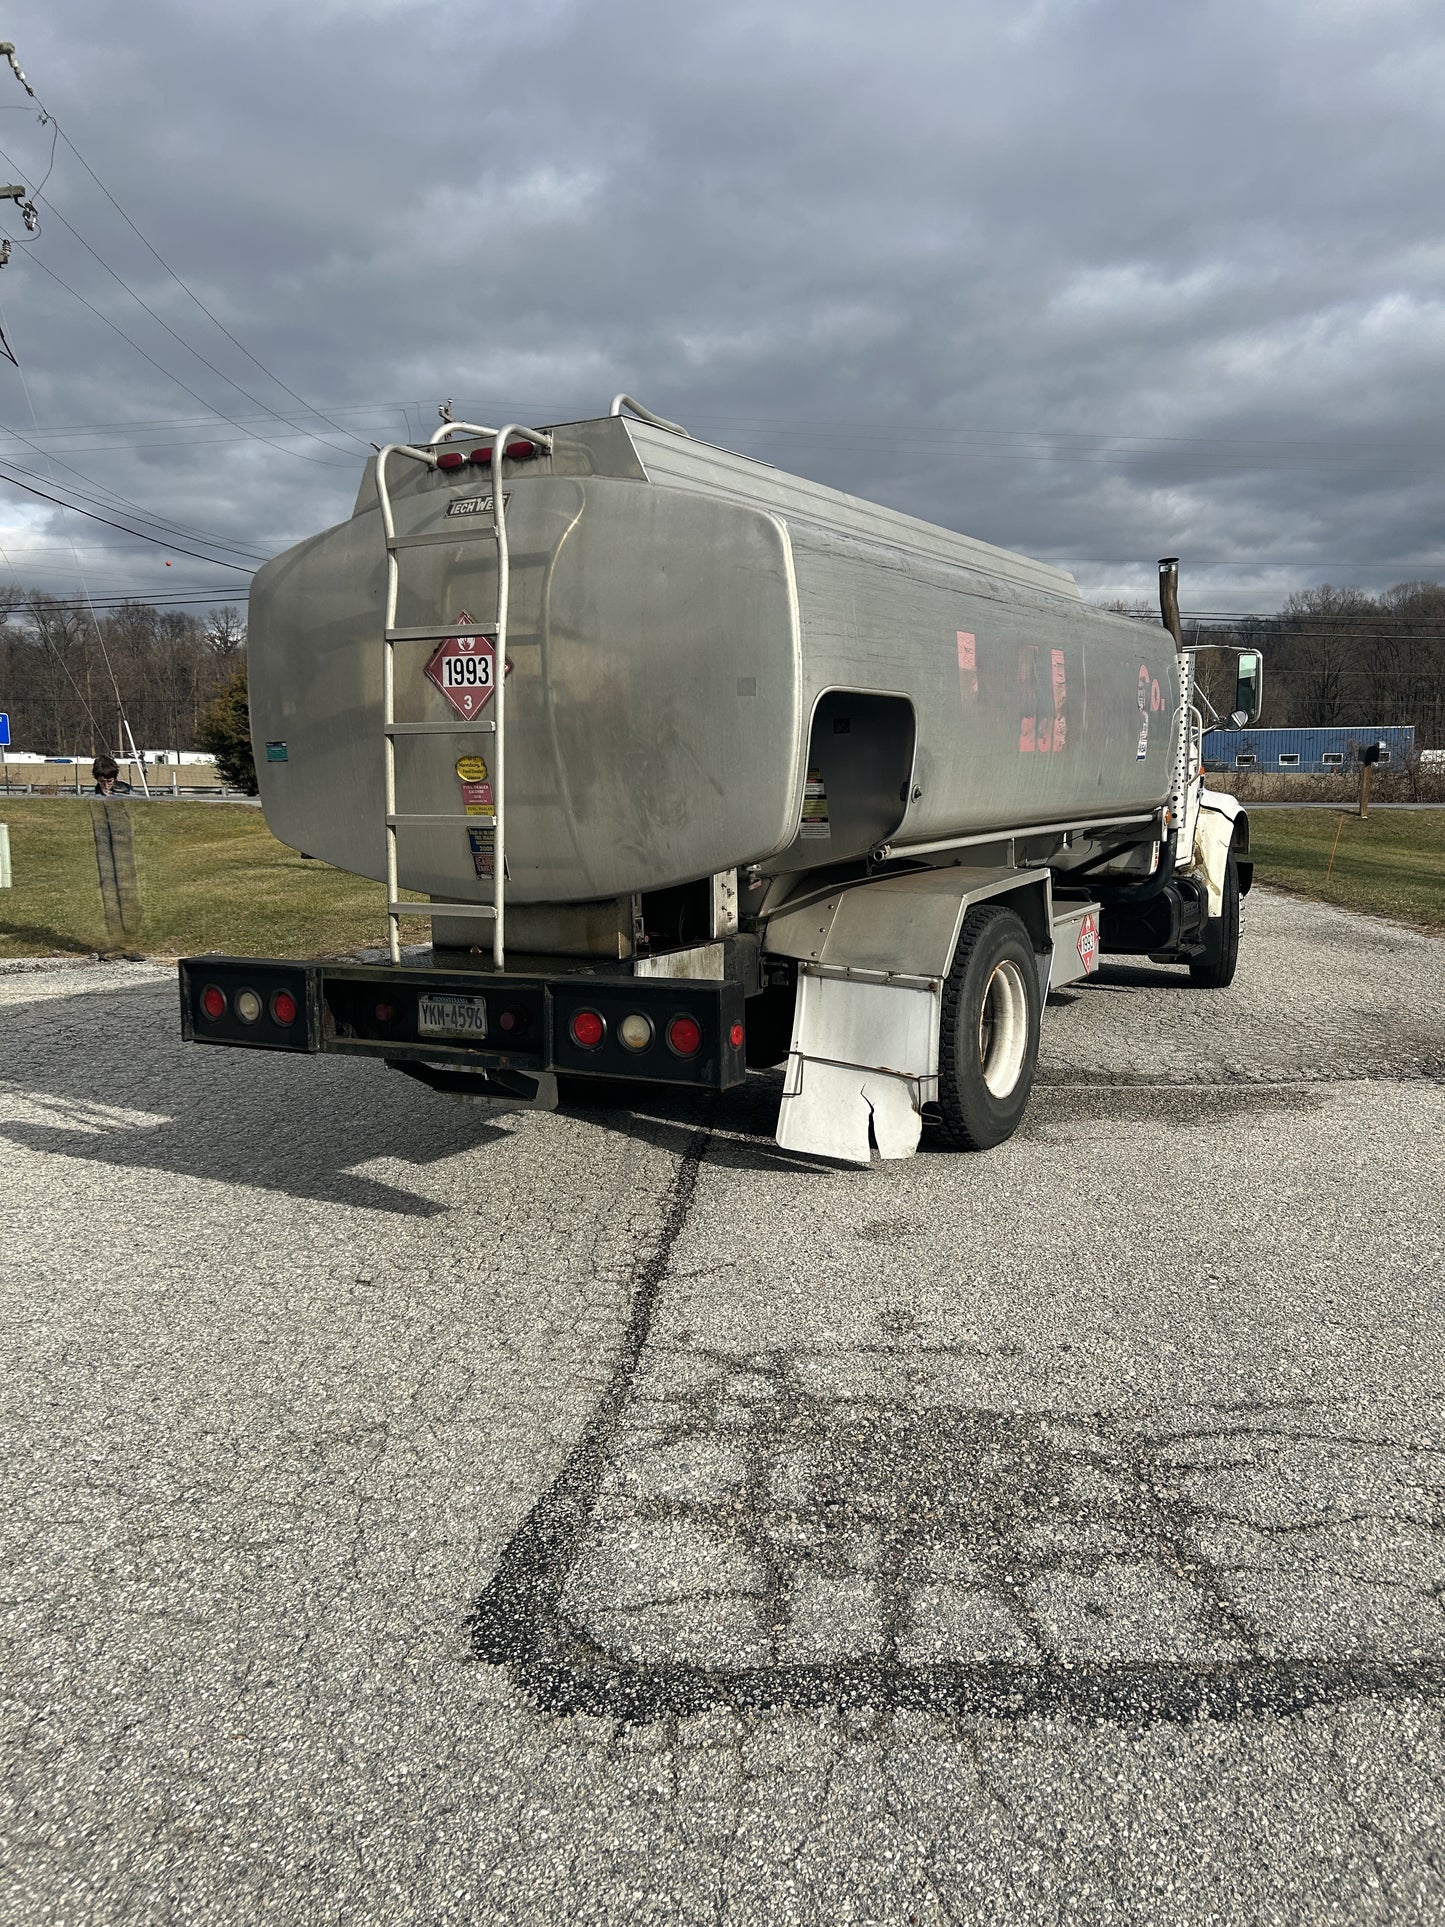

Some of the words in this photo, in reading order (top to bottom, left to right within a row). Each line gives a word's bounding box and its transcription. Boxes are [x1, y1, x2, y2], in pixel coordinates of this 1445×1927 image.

[445, 656, 490, 686] 1993
[463, 694, 473, 710] 3
[422, 1004, 482, 1029] YKM-4596
